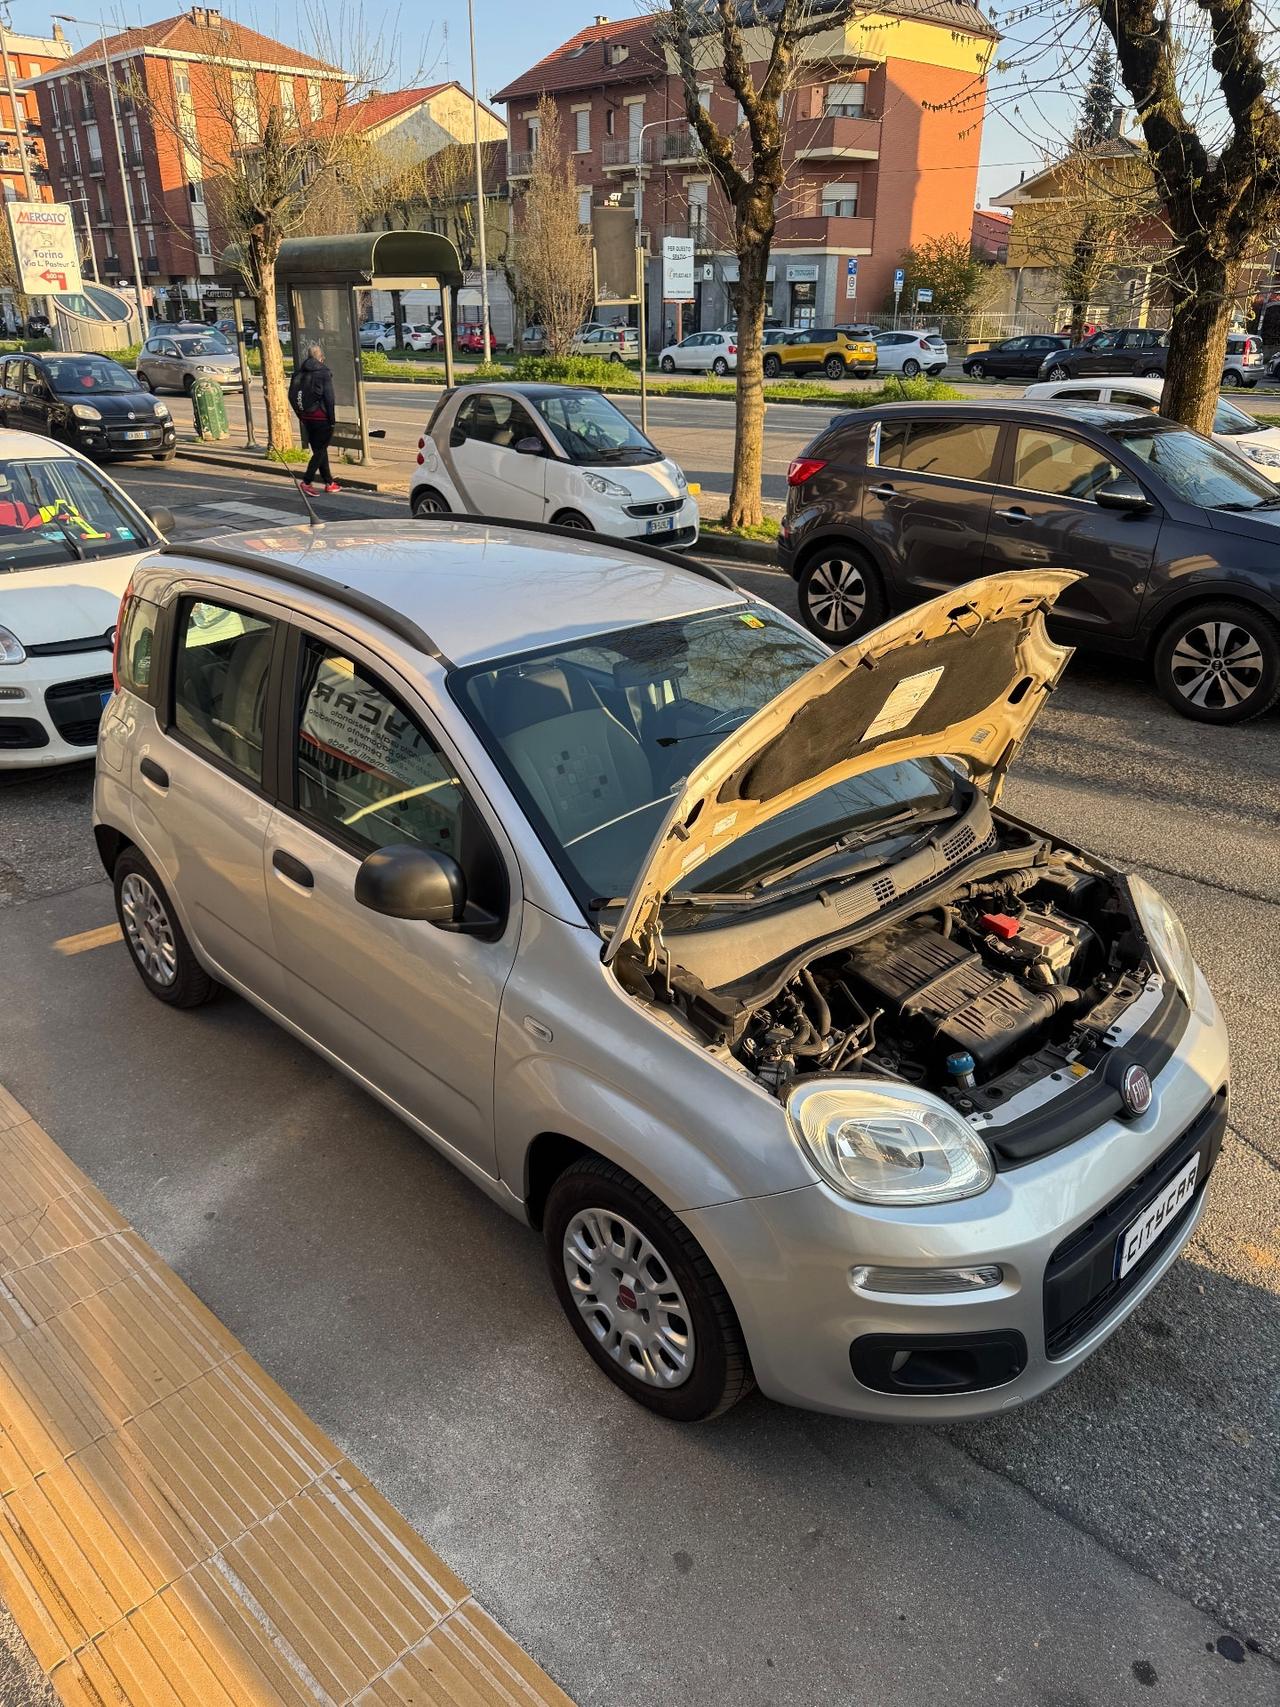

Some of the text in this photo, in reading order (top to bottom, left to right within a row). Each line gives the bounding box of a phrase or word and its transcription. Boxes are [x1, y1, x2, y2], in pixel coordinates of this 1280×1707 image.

[33, 249, 64, 259] Torino
[24, 259, 37, 267] Via
[45, 260, 70, 268] Pasteur
[896, 271, 903, 280] P
[1131, 1075, 1148, 1104] FIAT
[1126, 1166, 1198, 1263] CITYCAR
